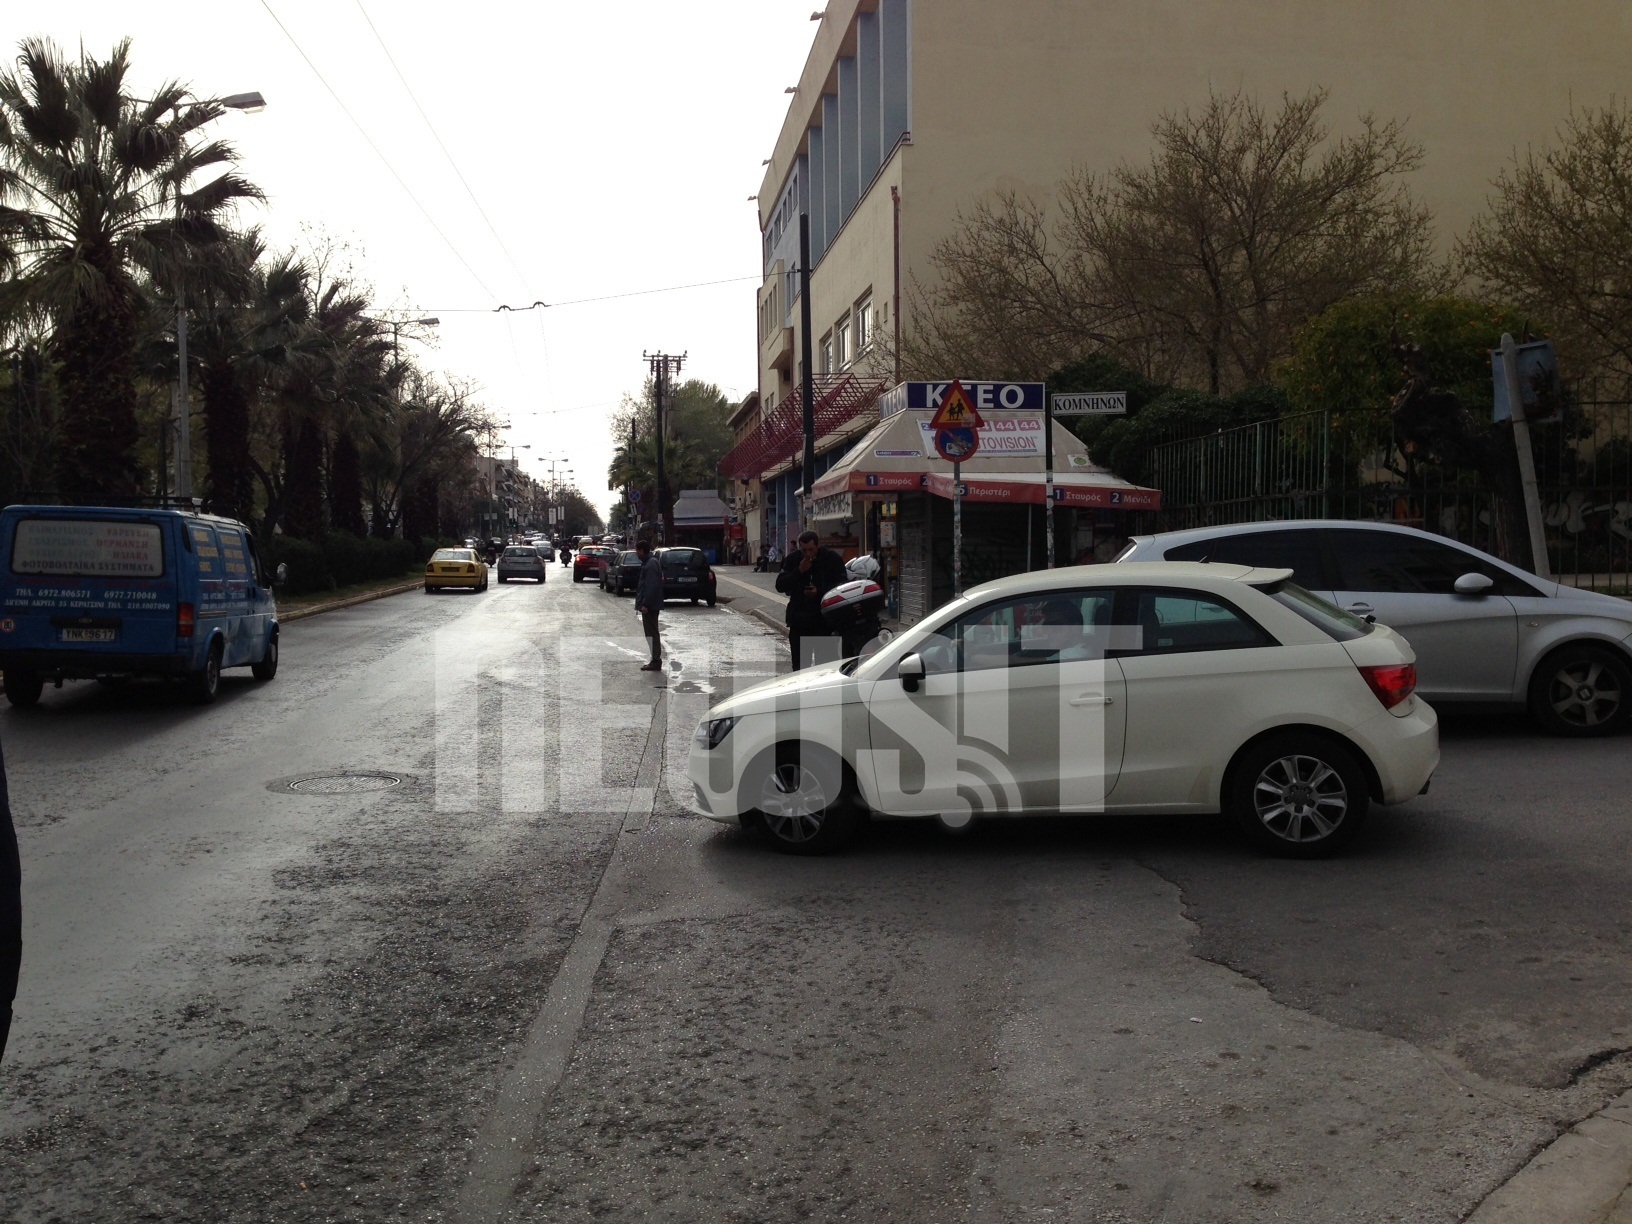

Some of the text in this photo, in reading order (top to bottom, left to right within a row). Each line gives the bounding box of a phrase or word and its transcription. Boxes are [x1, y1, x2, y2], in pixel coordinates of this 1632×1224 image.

[926, 384, 1025, 409] ΚΕΟ
[1054, 396, 1125, 411] ΚΟΜΝΗΝΩΝ
[978, 436, 1036, 449] TOVISION
[879, 477, 912, 486] Σταυρός
[969, 485, 1011, 497] Περιστέρι
[1065, 492, 1101, 502] Σταυρός
[1112, 492, 1120, 502] 2
[96, 540, 149, 549] ΘΕΡΜΑΝΣΗ
[98, 562, 154, 572] ΣΥΣΤΗΜΑΤΑ
[38, 588, 91, 598] 6972.806571
